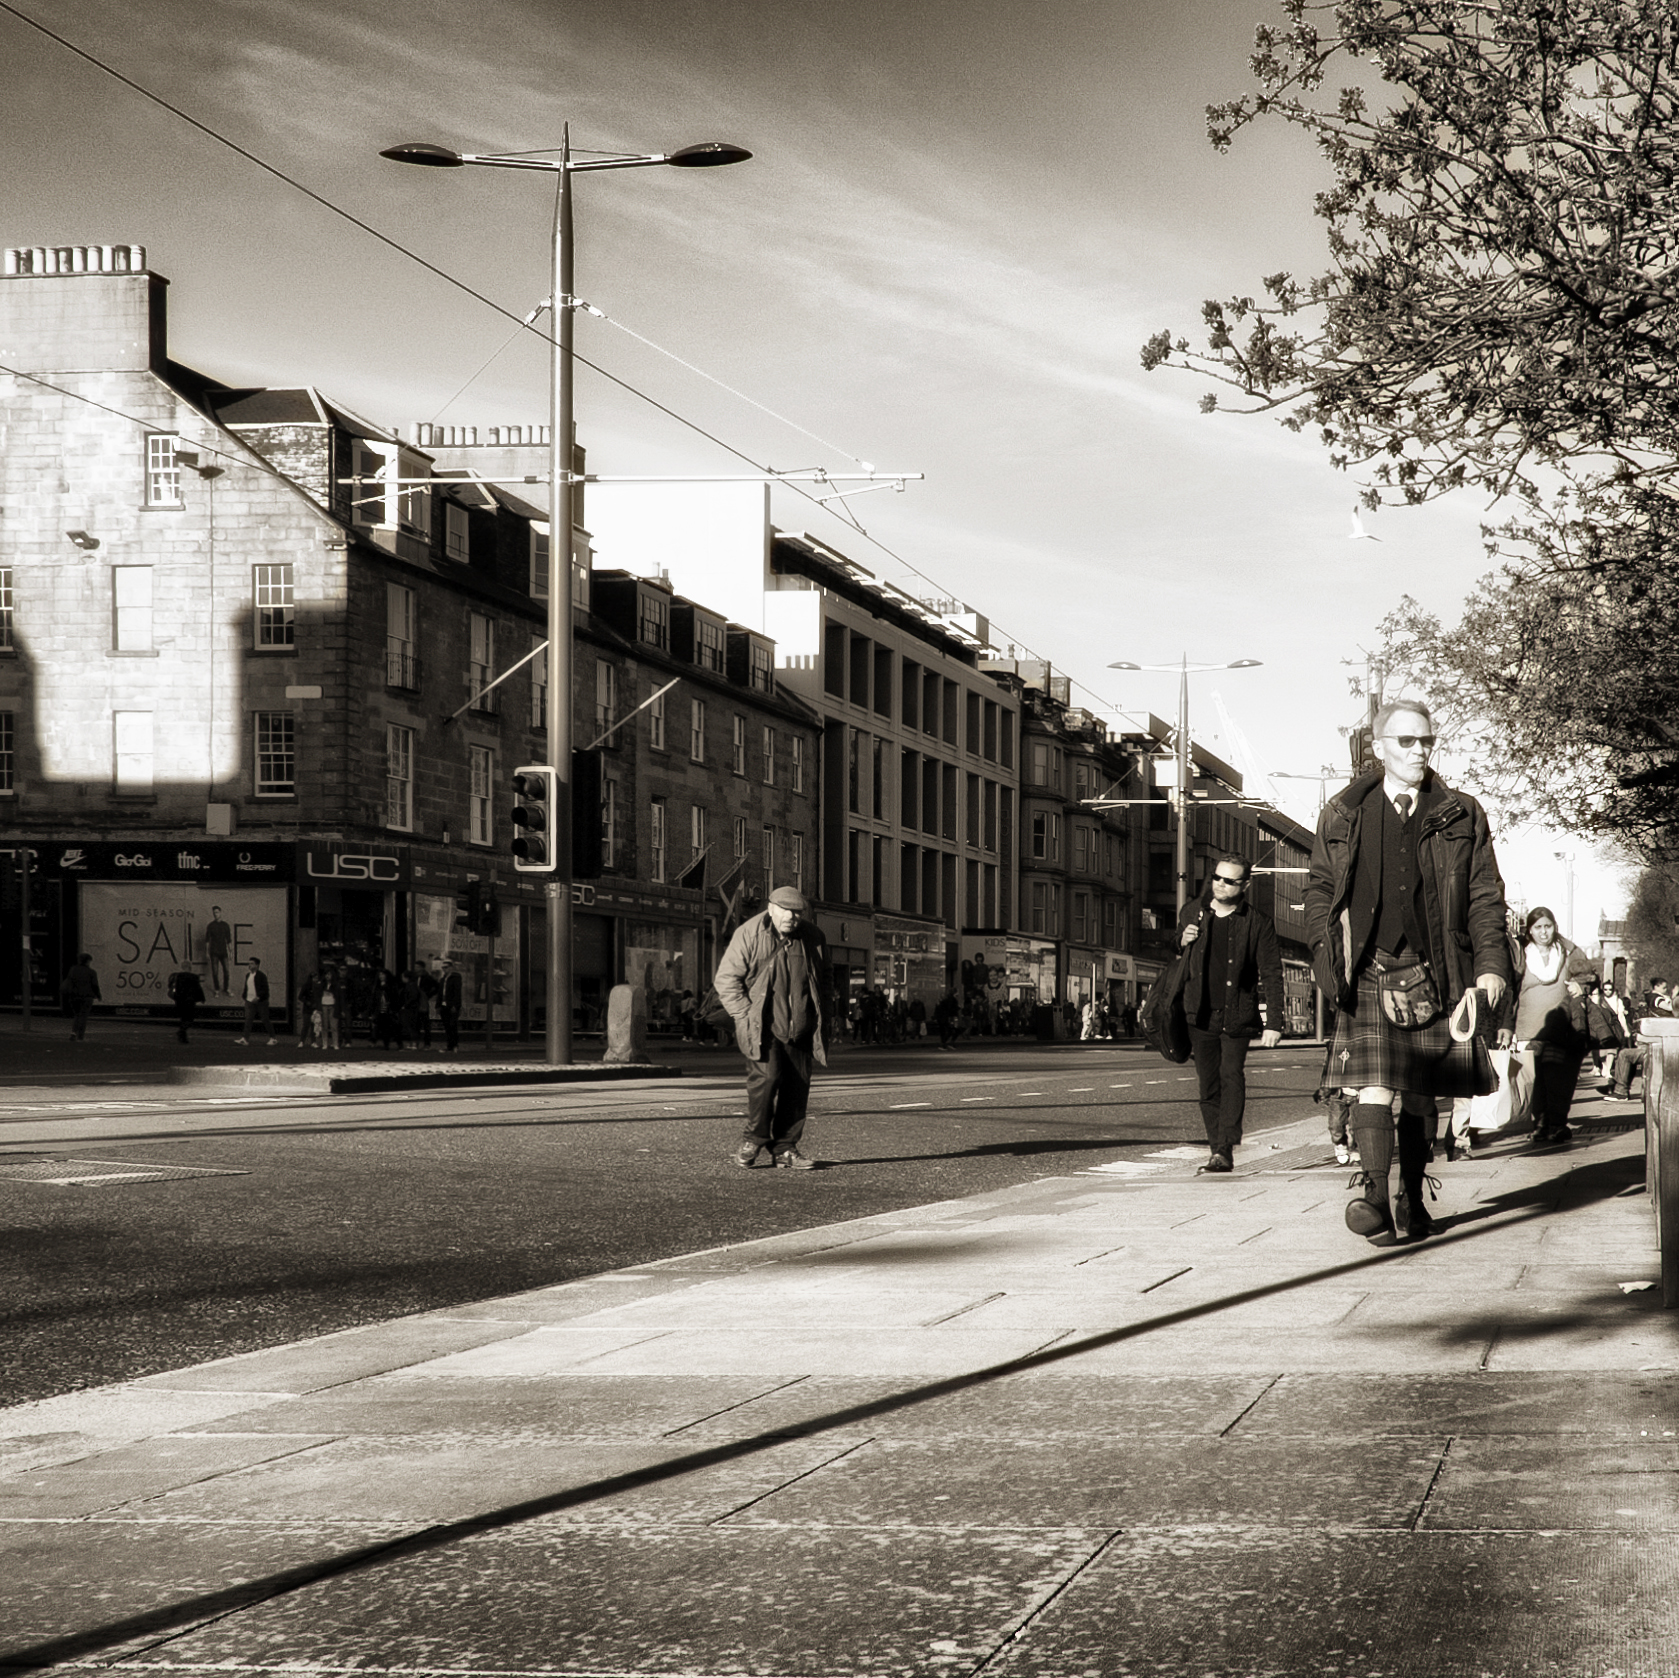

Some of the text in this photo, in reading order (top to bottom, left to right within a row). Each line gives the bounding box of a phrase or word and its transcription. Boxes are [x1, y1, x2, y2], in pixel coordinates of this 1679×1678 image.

[307, 852, 399, 881] USC
[118, 908, 195, 918] MID SEASON
[116, 920, 253, 966] SALE
[984, 937, 1006, 948] KIDS
[115, 971, 162, 990] 50%
